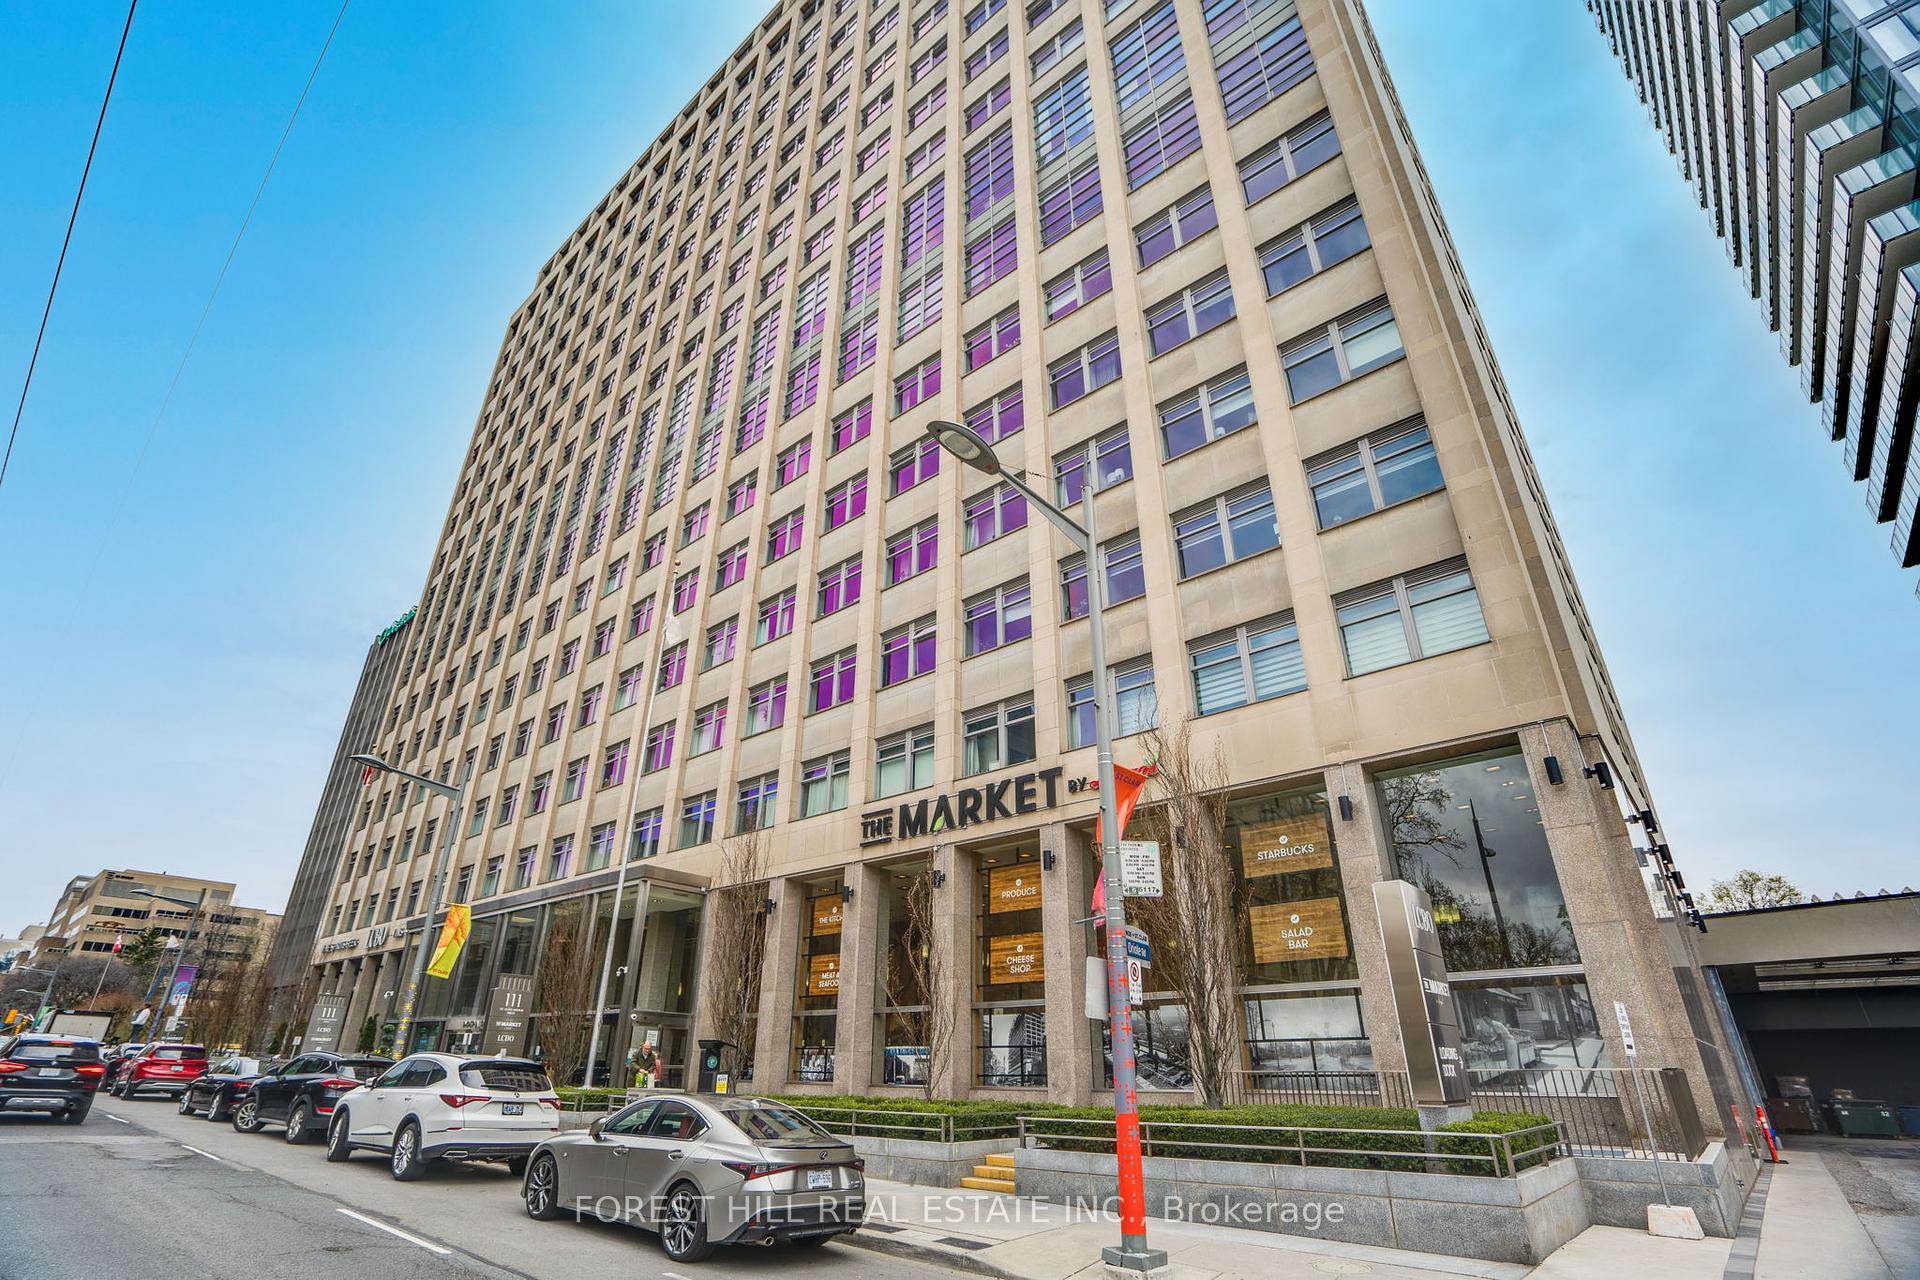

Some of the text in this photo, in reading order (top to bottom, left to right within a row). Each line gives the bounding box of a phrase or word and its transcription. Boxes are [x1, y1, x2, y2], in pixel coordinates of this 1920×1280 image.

[860, 815, 893, 838] THE
[898, 767, 1063, 838] MARKET
[1068, 777, 1087, 793] BY
[1257, 843, 1315, 861] STARBUCKS
[1001, 886, 1037, 899] PRODUCE
[1411, 904, 1435, 934] LCBO
[1281, 926, 1313, 939] SALAD
[1288, 939, 1309, 950] BAR
[1006, 955, 1035, 965] CHEESE
[1010, 965, 1031, 974] SHOP
[505, 993, 522, 1008] 111
[321, 1008, 337, 1018] 111
